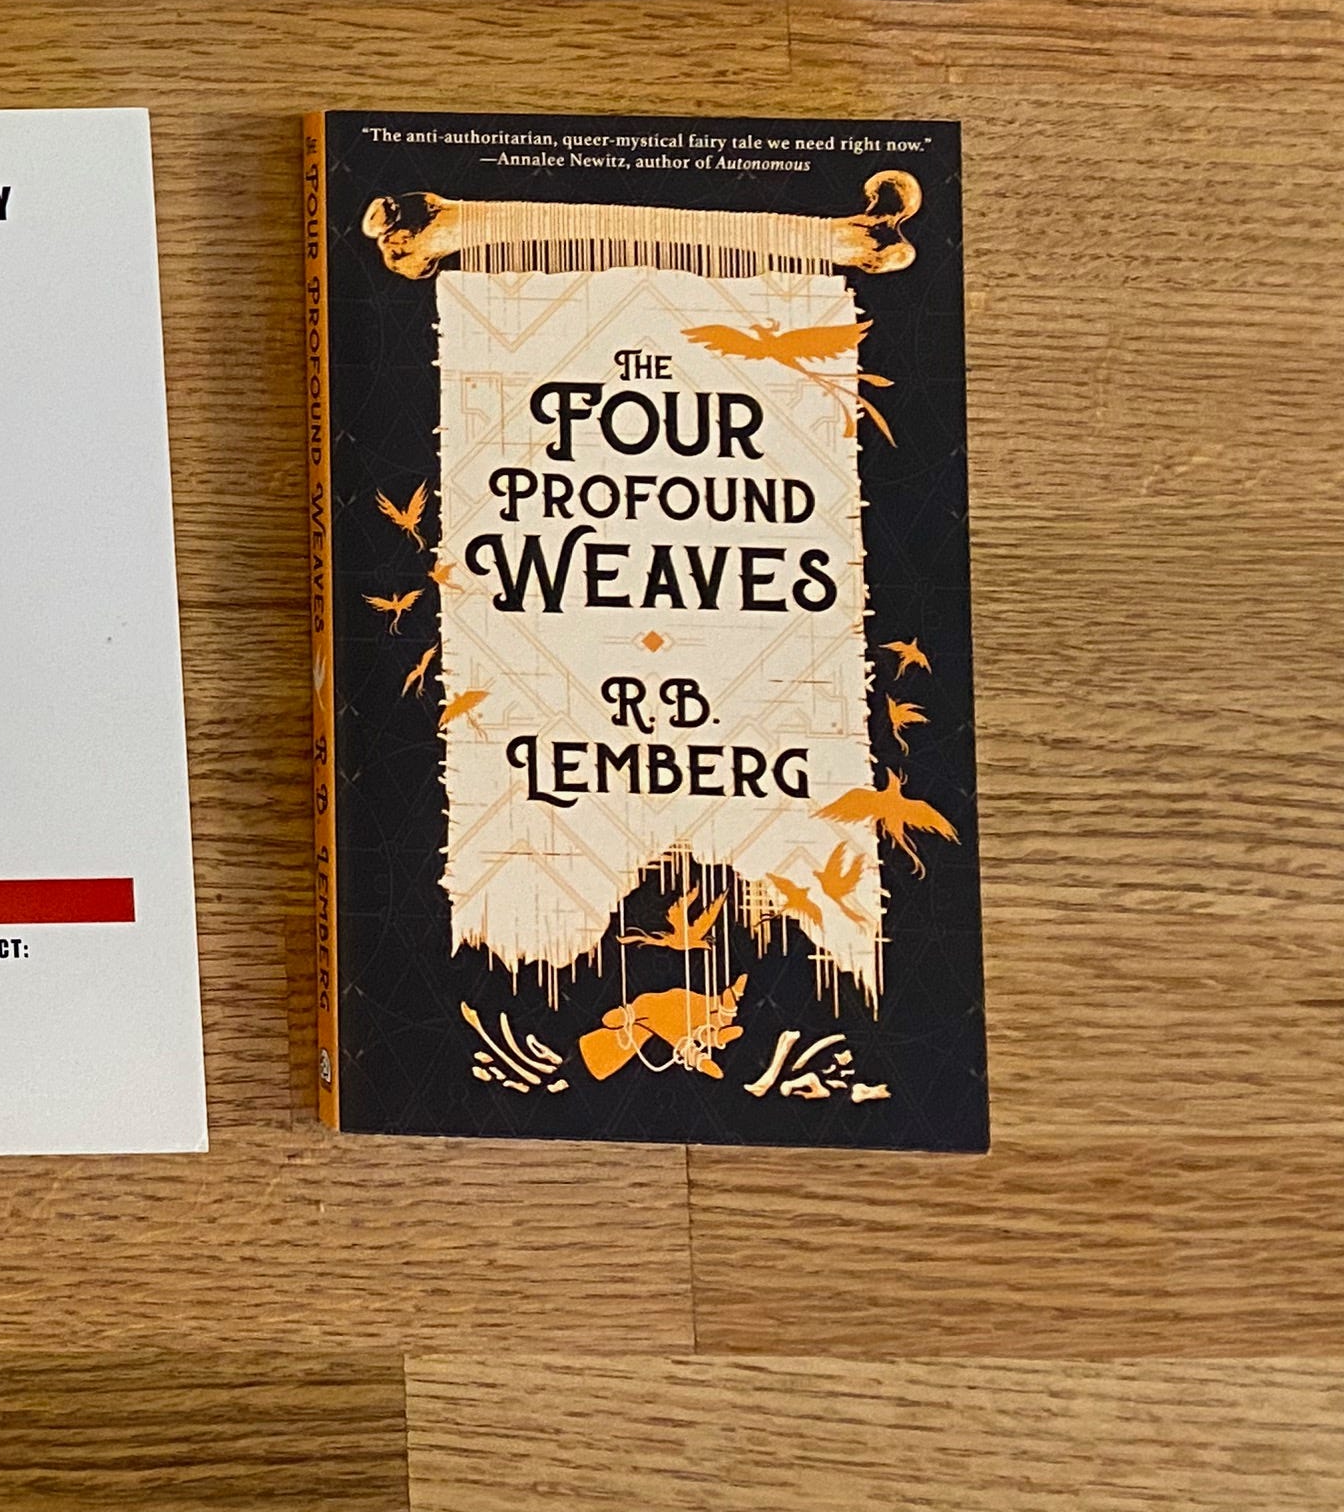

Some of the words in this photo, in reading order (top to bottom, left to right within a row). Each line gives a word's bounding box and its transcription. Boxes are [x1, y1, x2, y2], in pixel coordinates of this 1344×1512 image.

[363, 128, 402, 143] “The
[406, 129, 558, 148] anti-authoritarian,
[562, 133, 683, 150] queer-mystical
[688, 133, 727, 151] fairy
[732, 135, 763, 150] tale
[768, 139, 790, 151] we
[795, 137, 834, 152] need
[838, 136, 881, 155] right
[570, 154, 631, 170] Newitz,
[636, 154, 691, 170] author
[695, 154, 714, 170] of
[716, 156, 810, 172] Autonomous
[308, 275, 321, 466] PROFOUND
[614, 349, 672, 381] THE
[529, 381, 764, 461] FOUR
[488, 467, 816, 523] PROFOUND
[313, 482, 325, 634] WEAVES
[464, 525, 838, 613] WEAVES
[506, 735, 810, 808] LEMBERG
